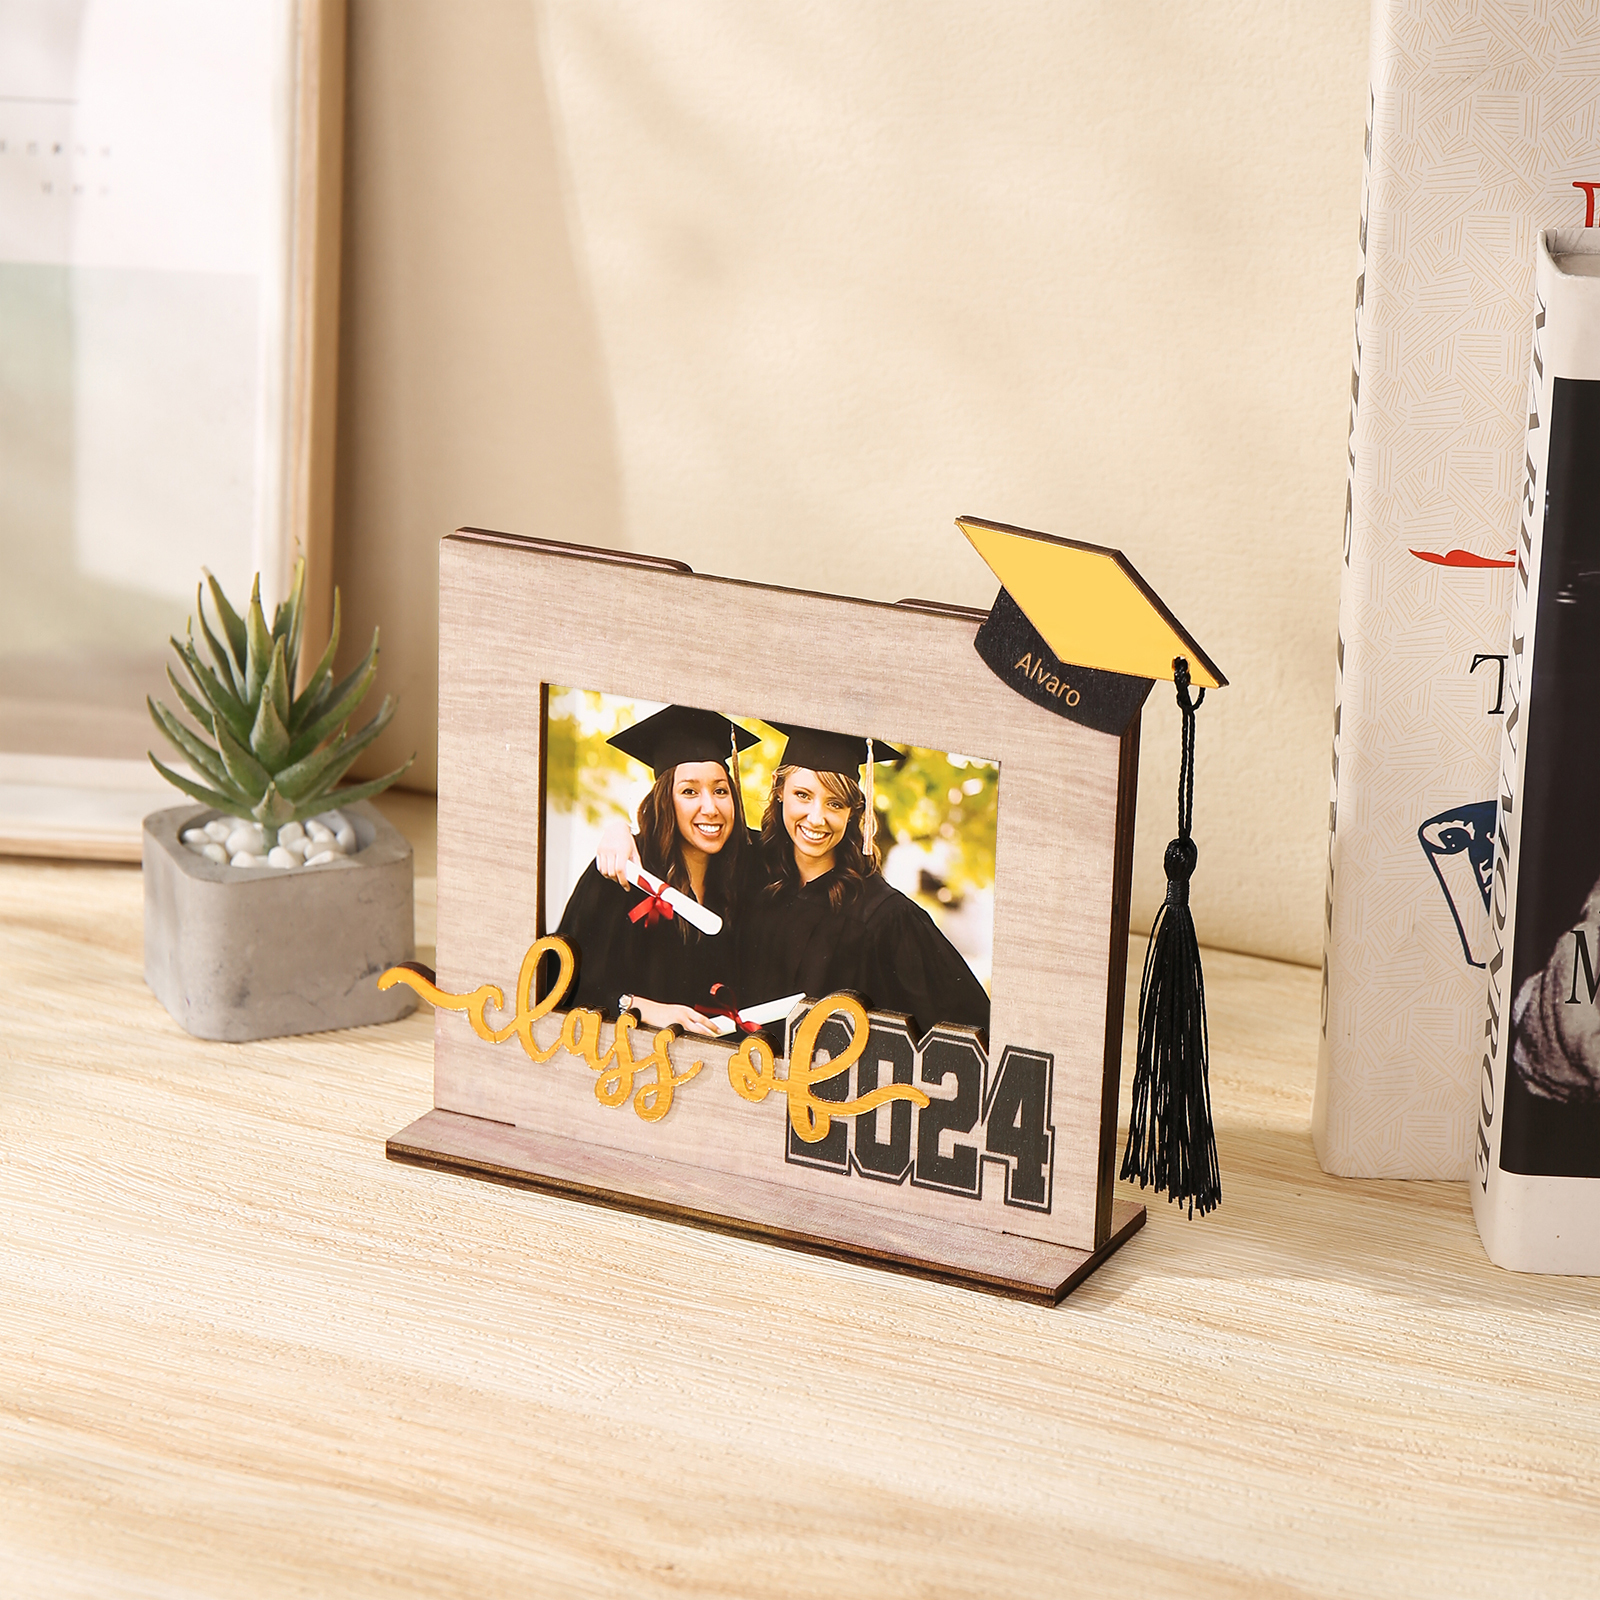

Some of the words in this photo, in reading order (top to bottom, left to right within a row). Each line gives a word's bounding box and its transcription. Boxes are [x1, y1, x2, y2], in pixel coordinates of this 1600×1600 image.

[1505, 283, 1547, 763] MARILYN
[1014, 652, 1081, 707] Alvaro
[377, 935, 704, 1123] class
[728, 993, 930, 1143] of
[1475, 760, 1515, 1195] MONROE
[785, 1002, 1055, 1214] 2024
